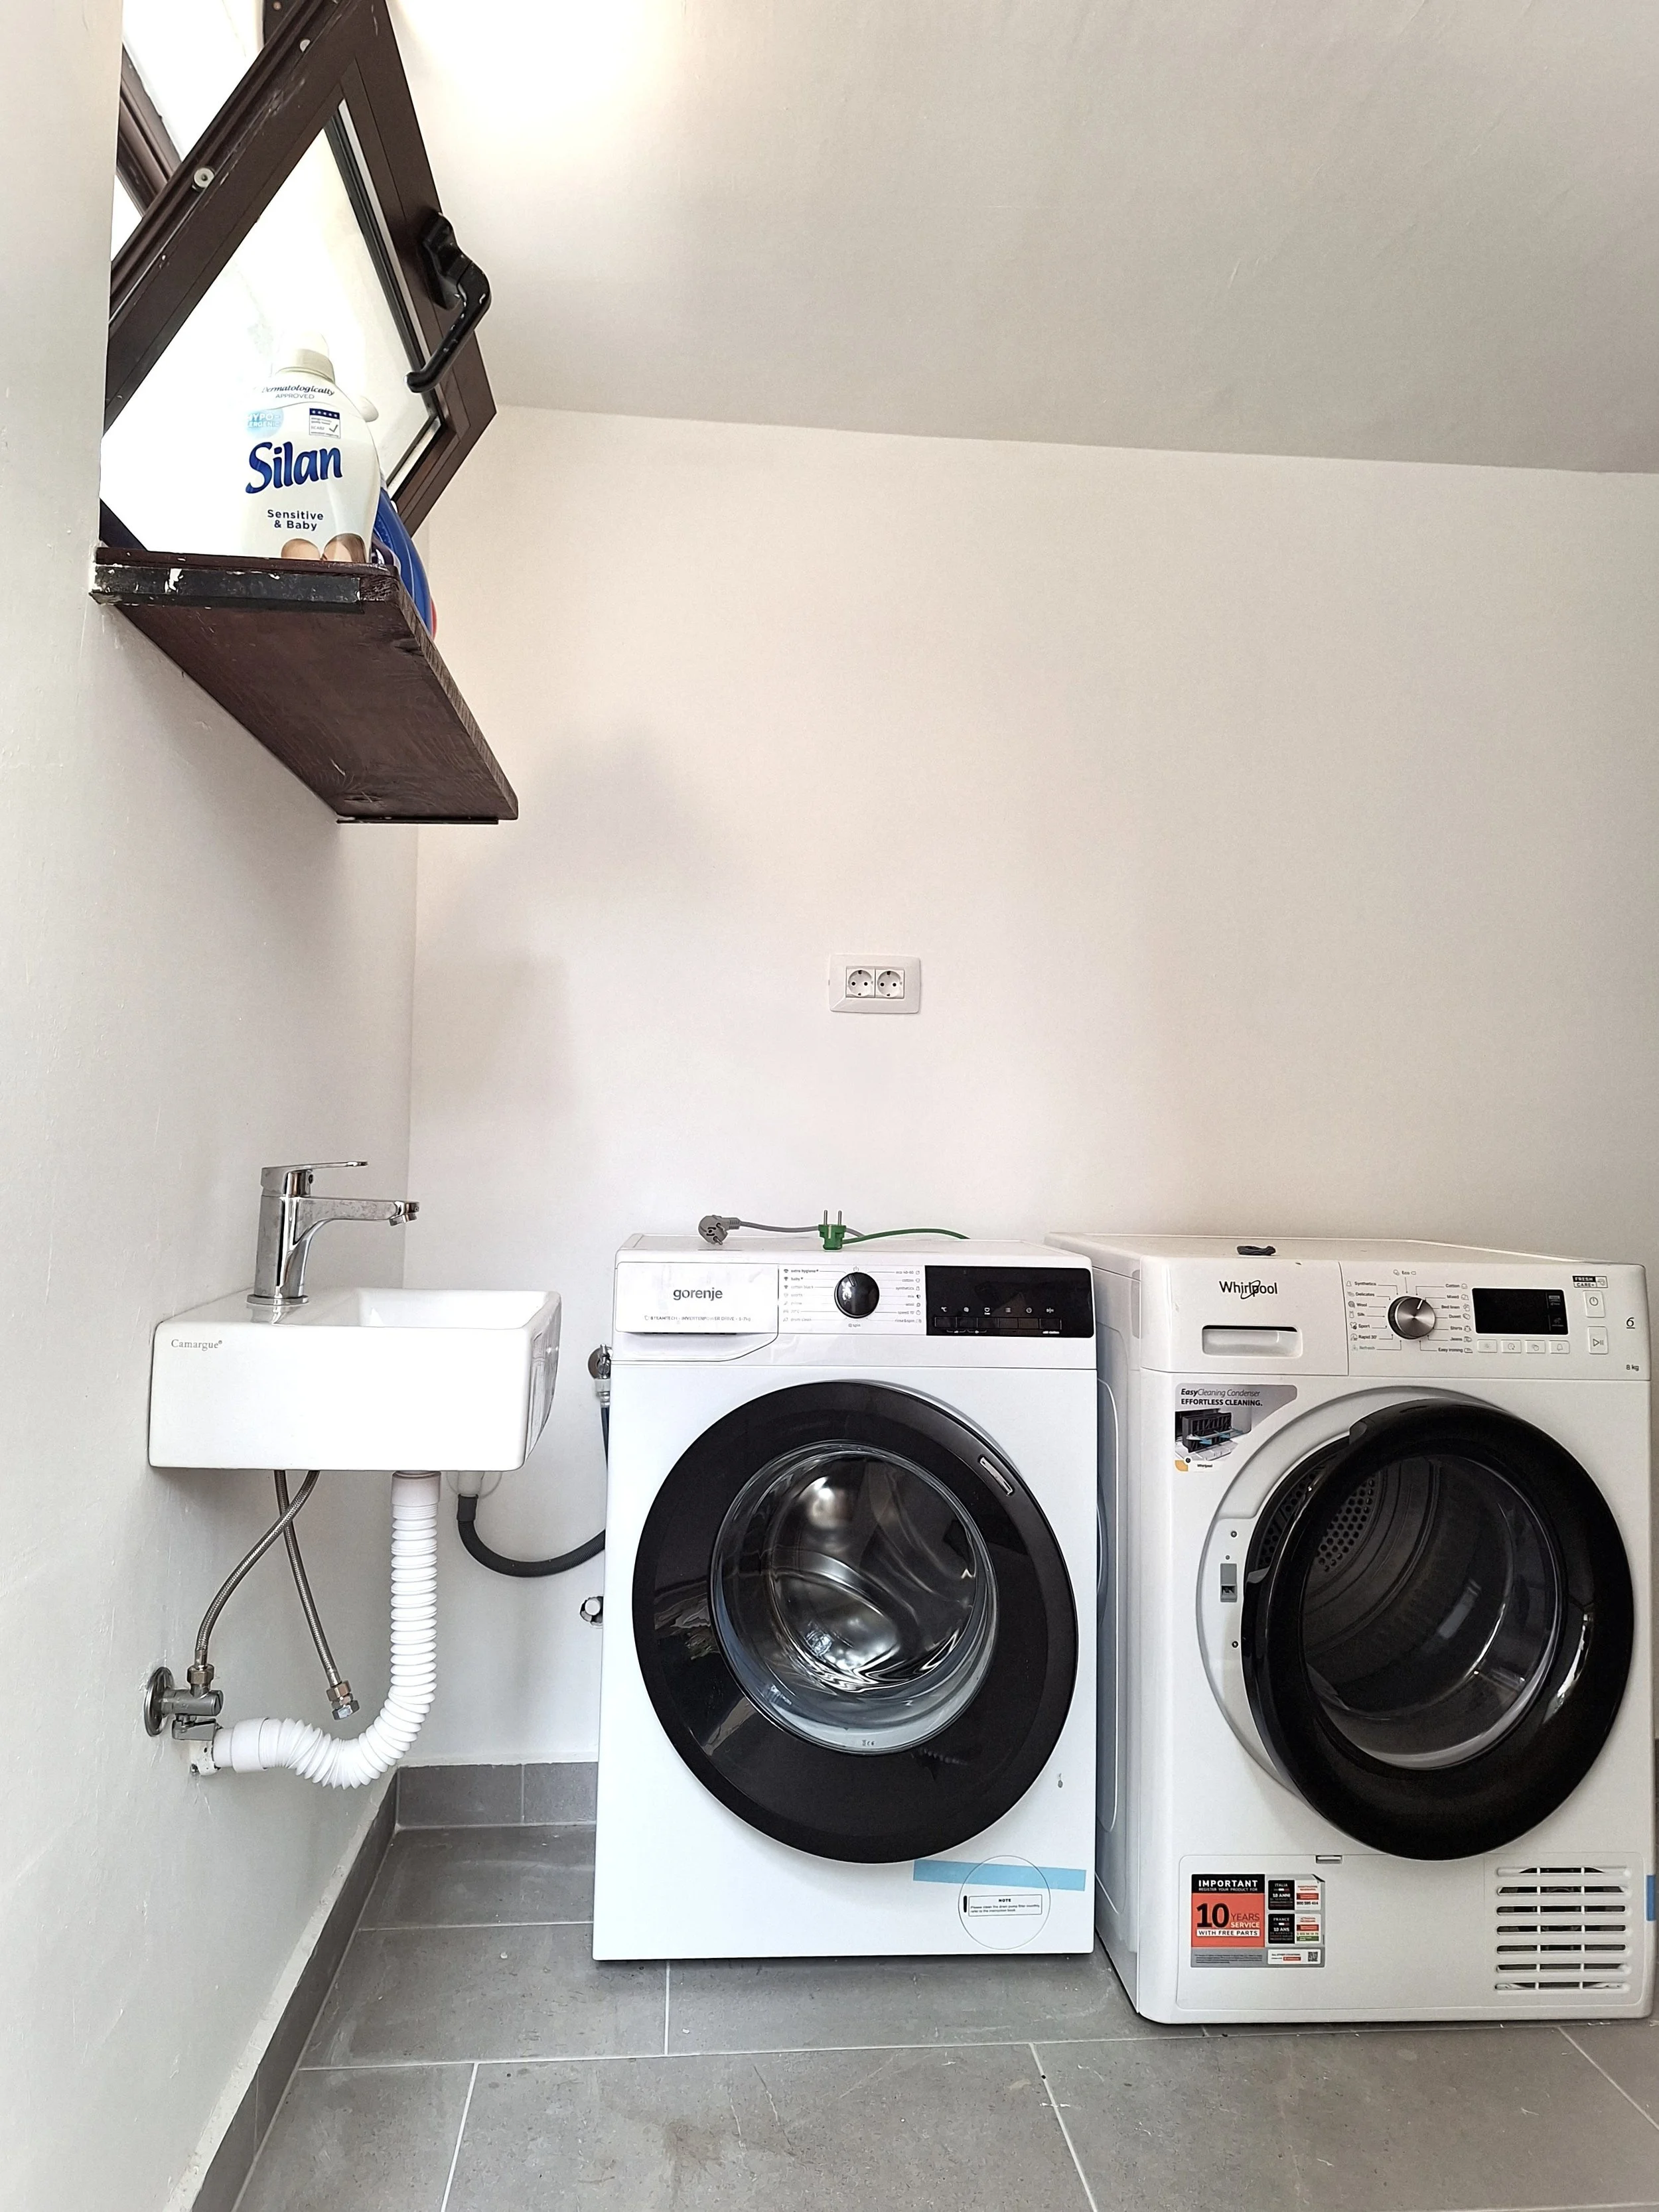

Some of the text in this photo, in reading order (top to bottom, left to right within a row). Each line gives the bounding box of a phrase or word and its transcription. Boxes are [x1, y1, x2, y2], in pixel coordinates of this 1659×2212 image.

[245, 441, 343, 494] Silan
[267, 509, 324, 521] Sensitive
[287, 520, 318, 531] Baby
[673, 1287, 723, 1301] gorenje
[1219, 1280, 1277, 1299] Whirlpool
[1181, 1388, 1225, 1397] EasyCleaning
[1196, 1903, 1230, 1928] 10
